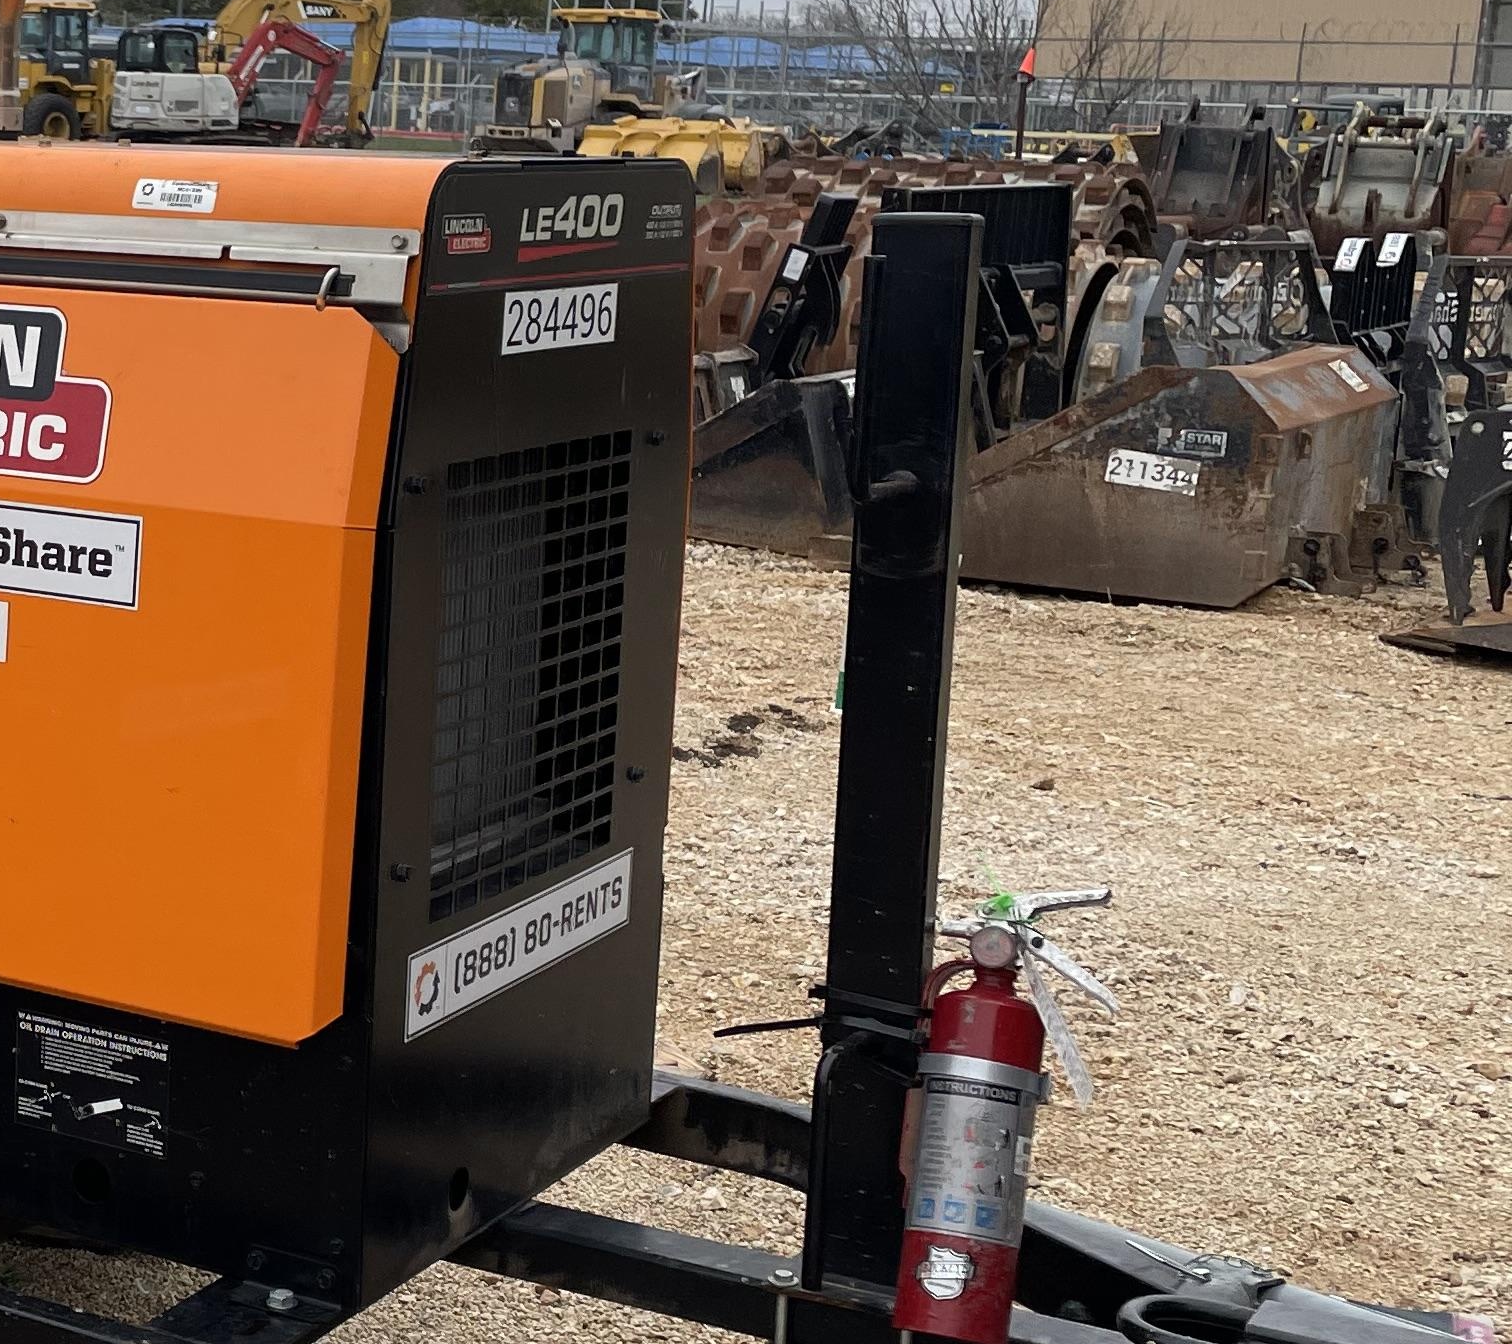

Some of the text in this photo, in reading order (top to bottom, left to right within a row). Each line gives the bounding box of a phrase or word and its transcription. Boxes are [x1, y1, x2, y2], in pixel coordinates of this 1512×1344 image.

[305, 5, 334, 16] SANY
[444, 217, 484, 235] LINCOLN
[519, 193, 625, 242] LE400
[453, 236, 487, 250] ELECTRIC
[506, 290, 613, 348] 284496
[1186, 432, 1223, 446] STAR
[454, 876, 623, 994] (888) 80-RENTS
[19, 1021, 167, 1062] OIL DRAIN OPERATION INSTRUCTIONS
[930, 1079, 1017, 1102] INSTRUCTIONS
